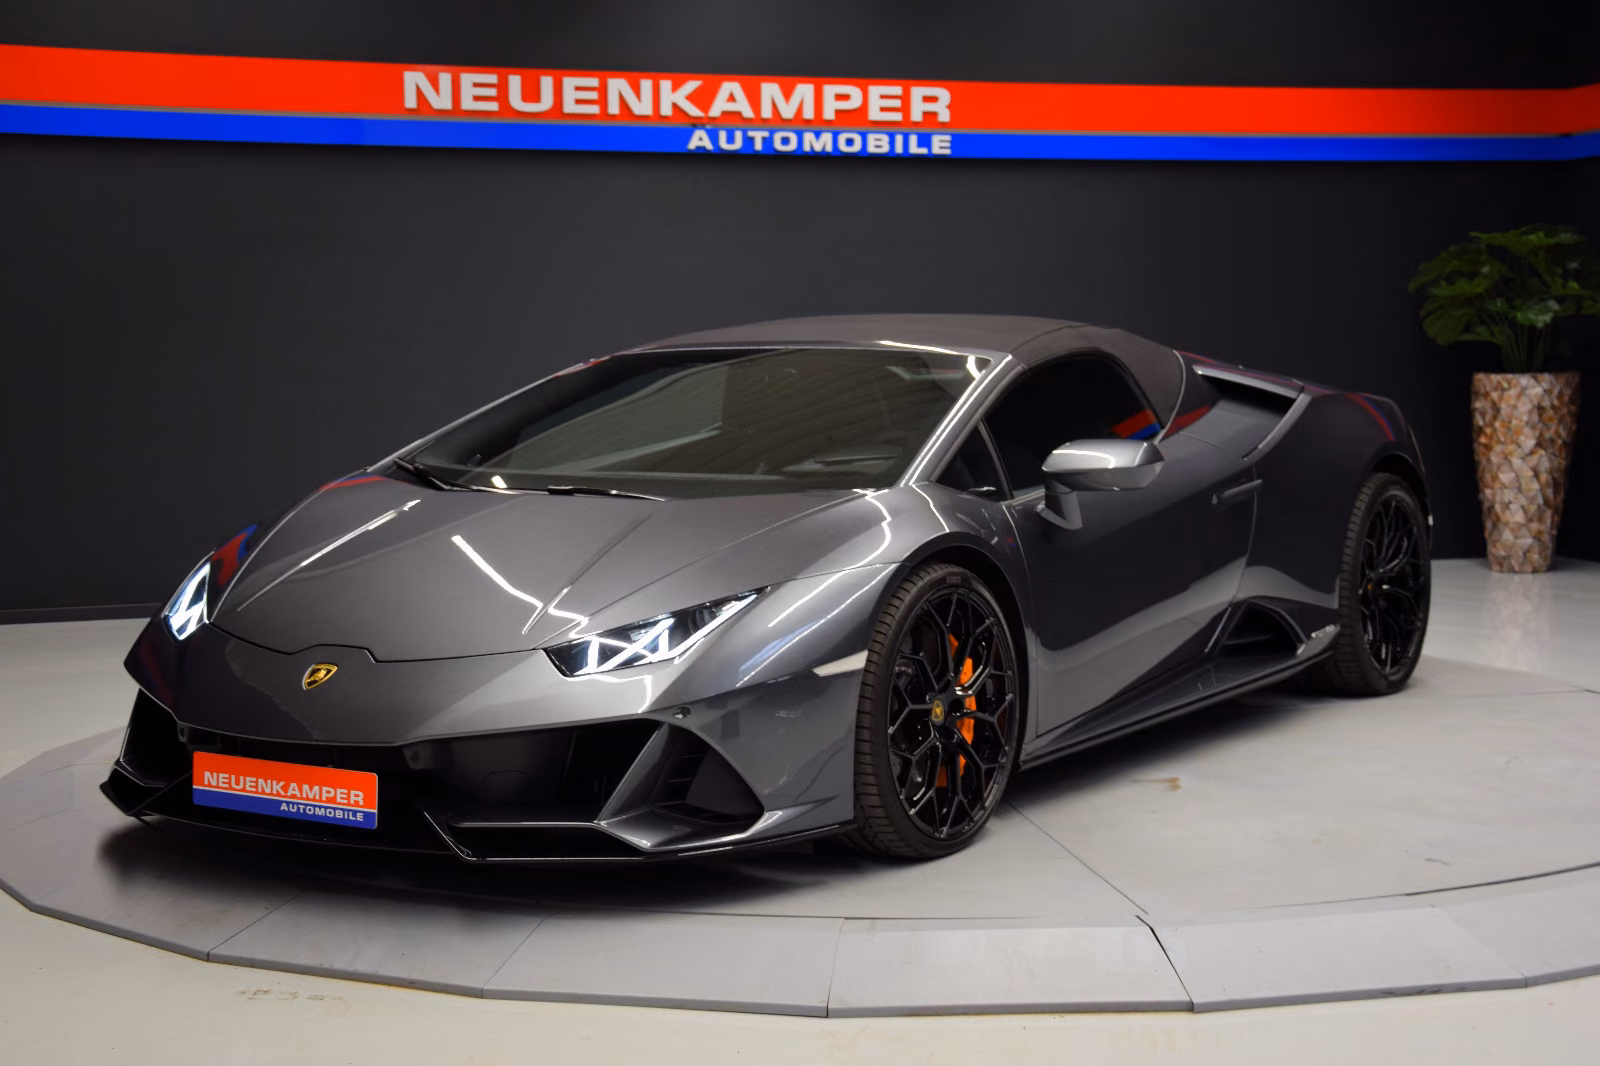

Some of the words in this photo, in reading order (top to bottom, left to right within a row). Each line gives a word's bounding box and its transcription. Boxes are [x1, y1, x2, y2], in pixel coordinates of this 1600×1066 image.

[403, 71, 952, 122] NEUENKAMPER
[687, 129, 952, 155] AUTOMOBILE
[204, 771, 364, 805] NEUENKAMPER
[280, 802, 364, 821] AUTOMOBILE
